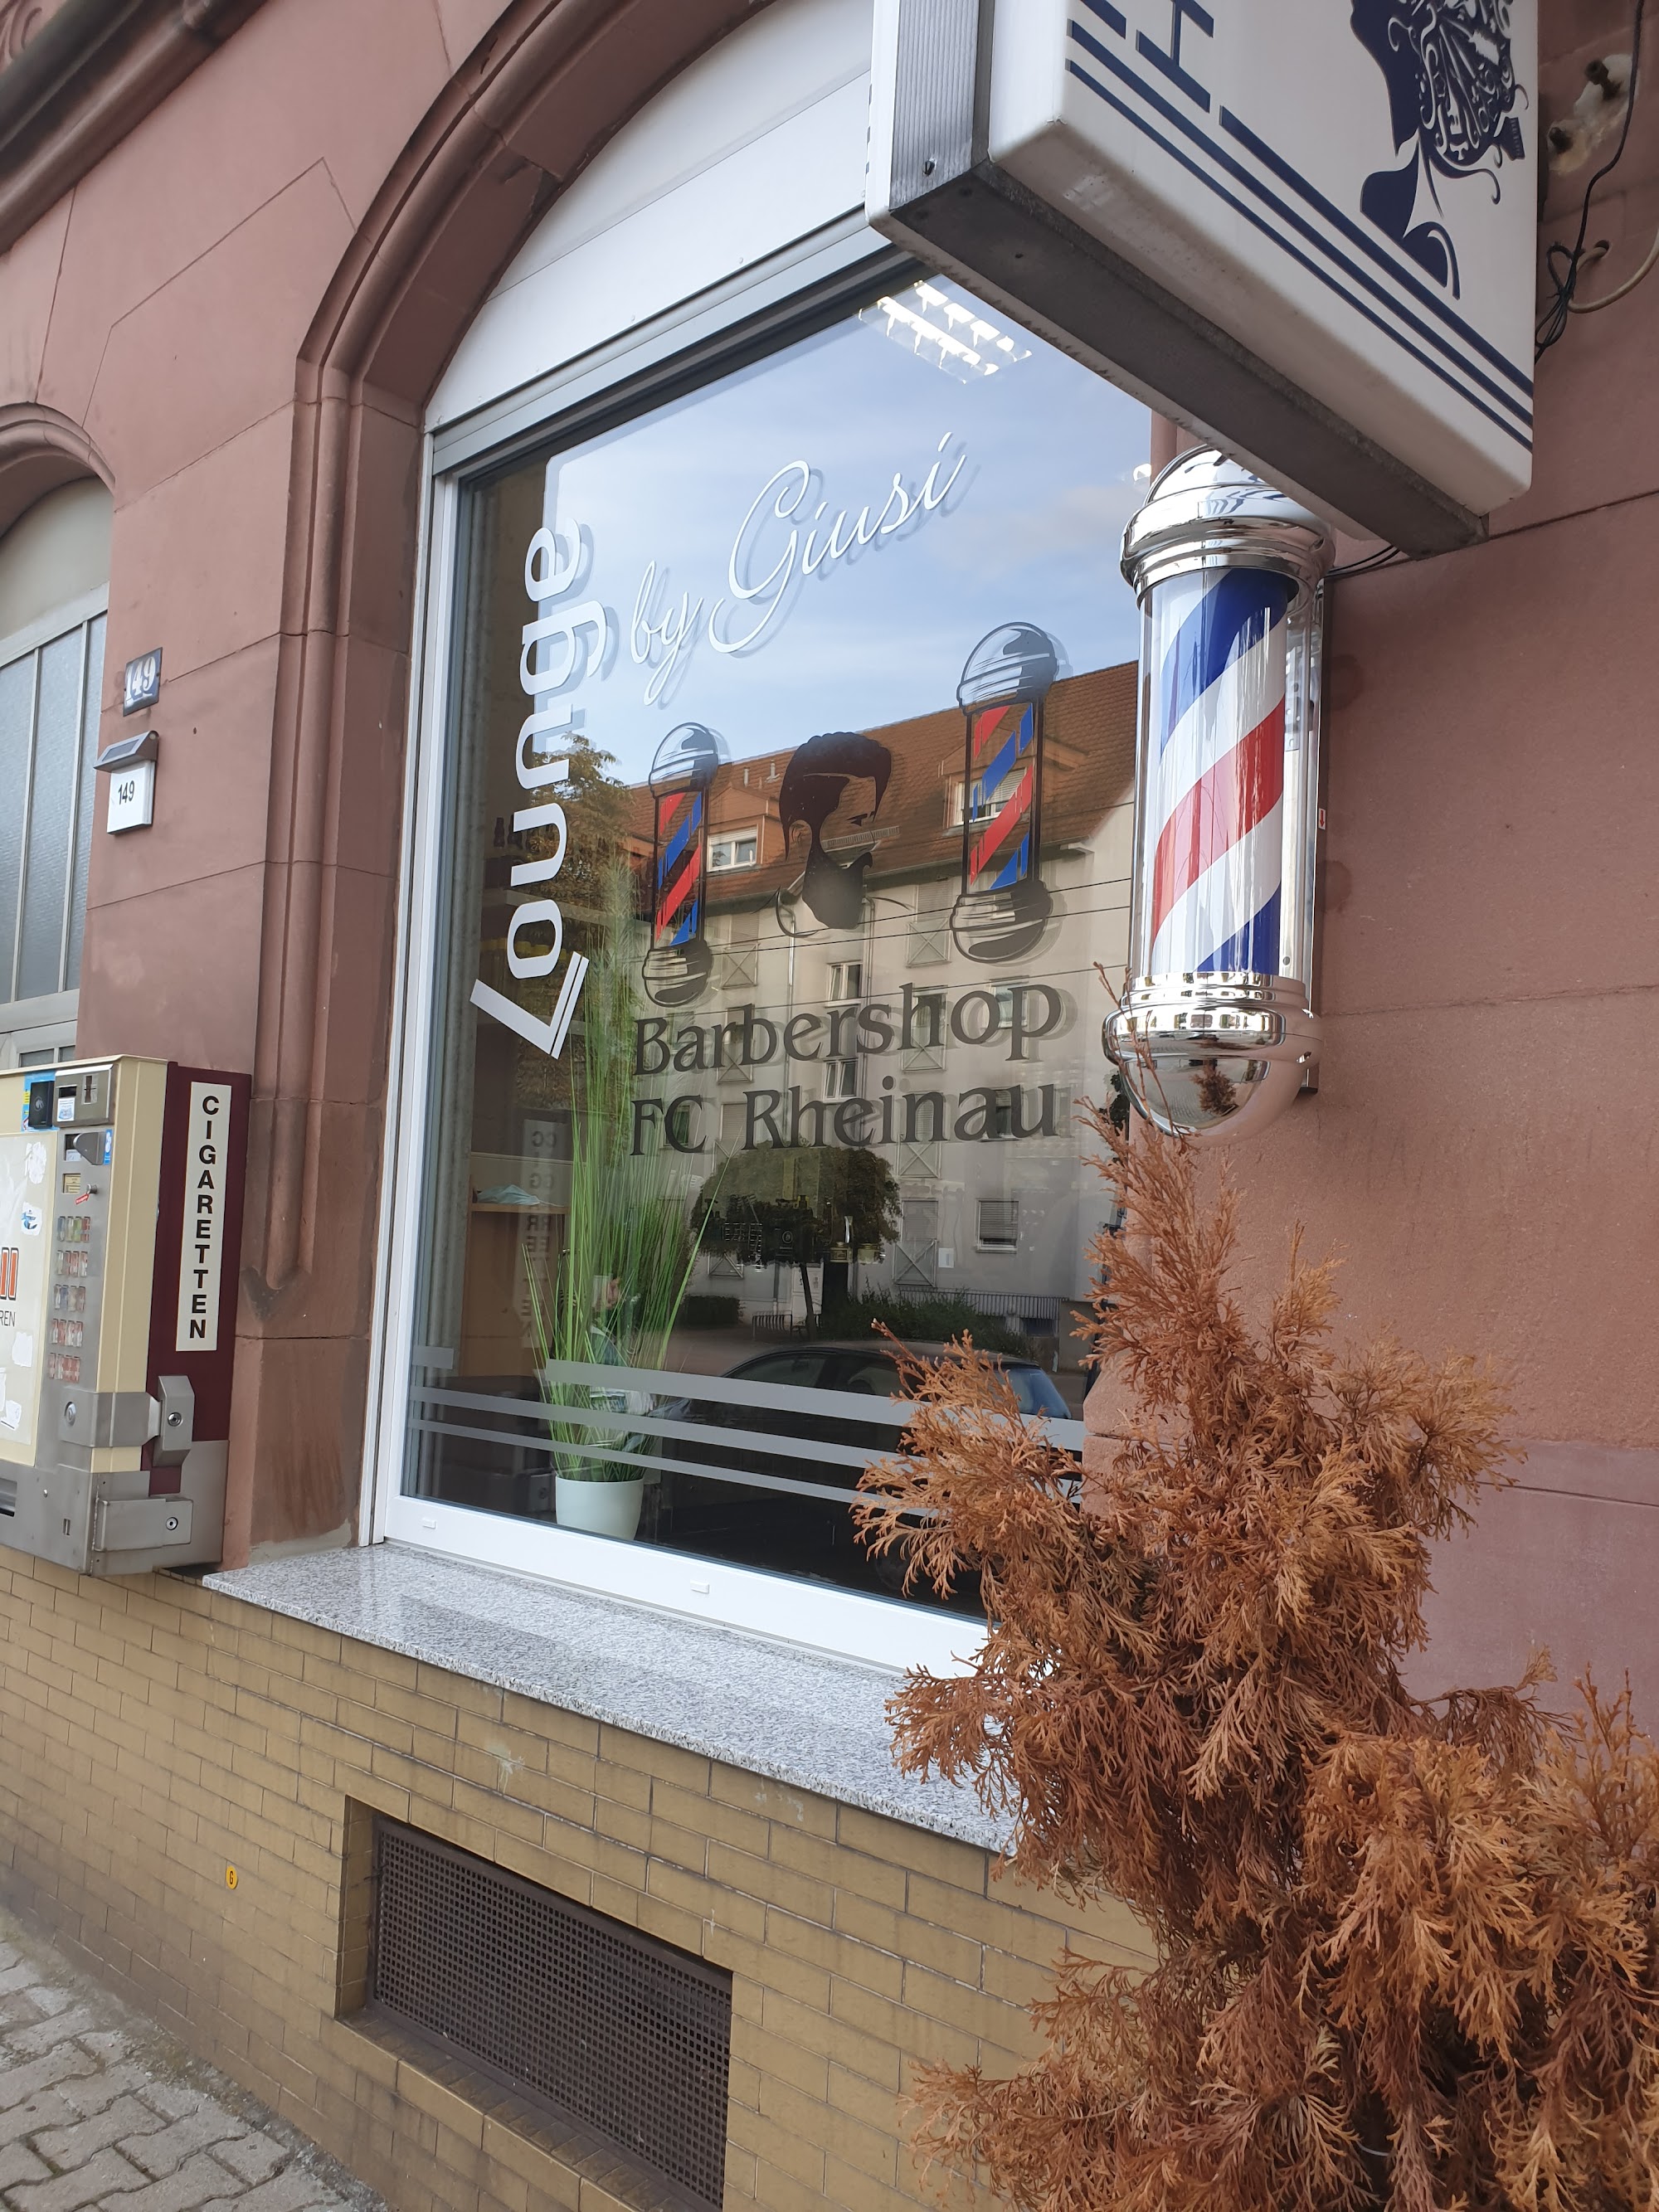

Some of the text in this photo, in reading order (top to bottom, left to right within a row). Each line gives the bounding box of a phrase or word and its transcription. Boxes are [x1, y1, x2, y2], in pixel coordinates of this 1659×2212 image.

[630, 431, 967, 706] by Giusi
[126, 656, 156, 702] 149
[118, 780, 135, 805] 149
[469, 518, 607, 1060] Lounge
[632, 982, 1062, 1076] Barbershop
[630, 1076, 1058, 1156] FC Rheinau
[189, 1096, 220, 1339] CIGARETTEN
